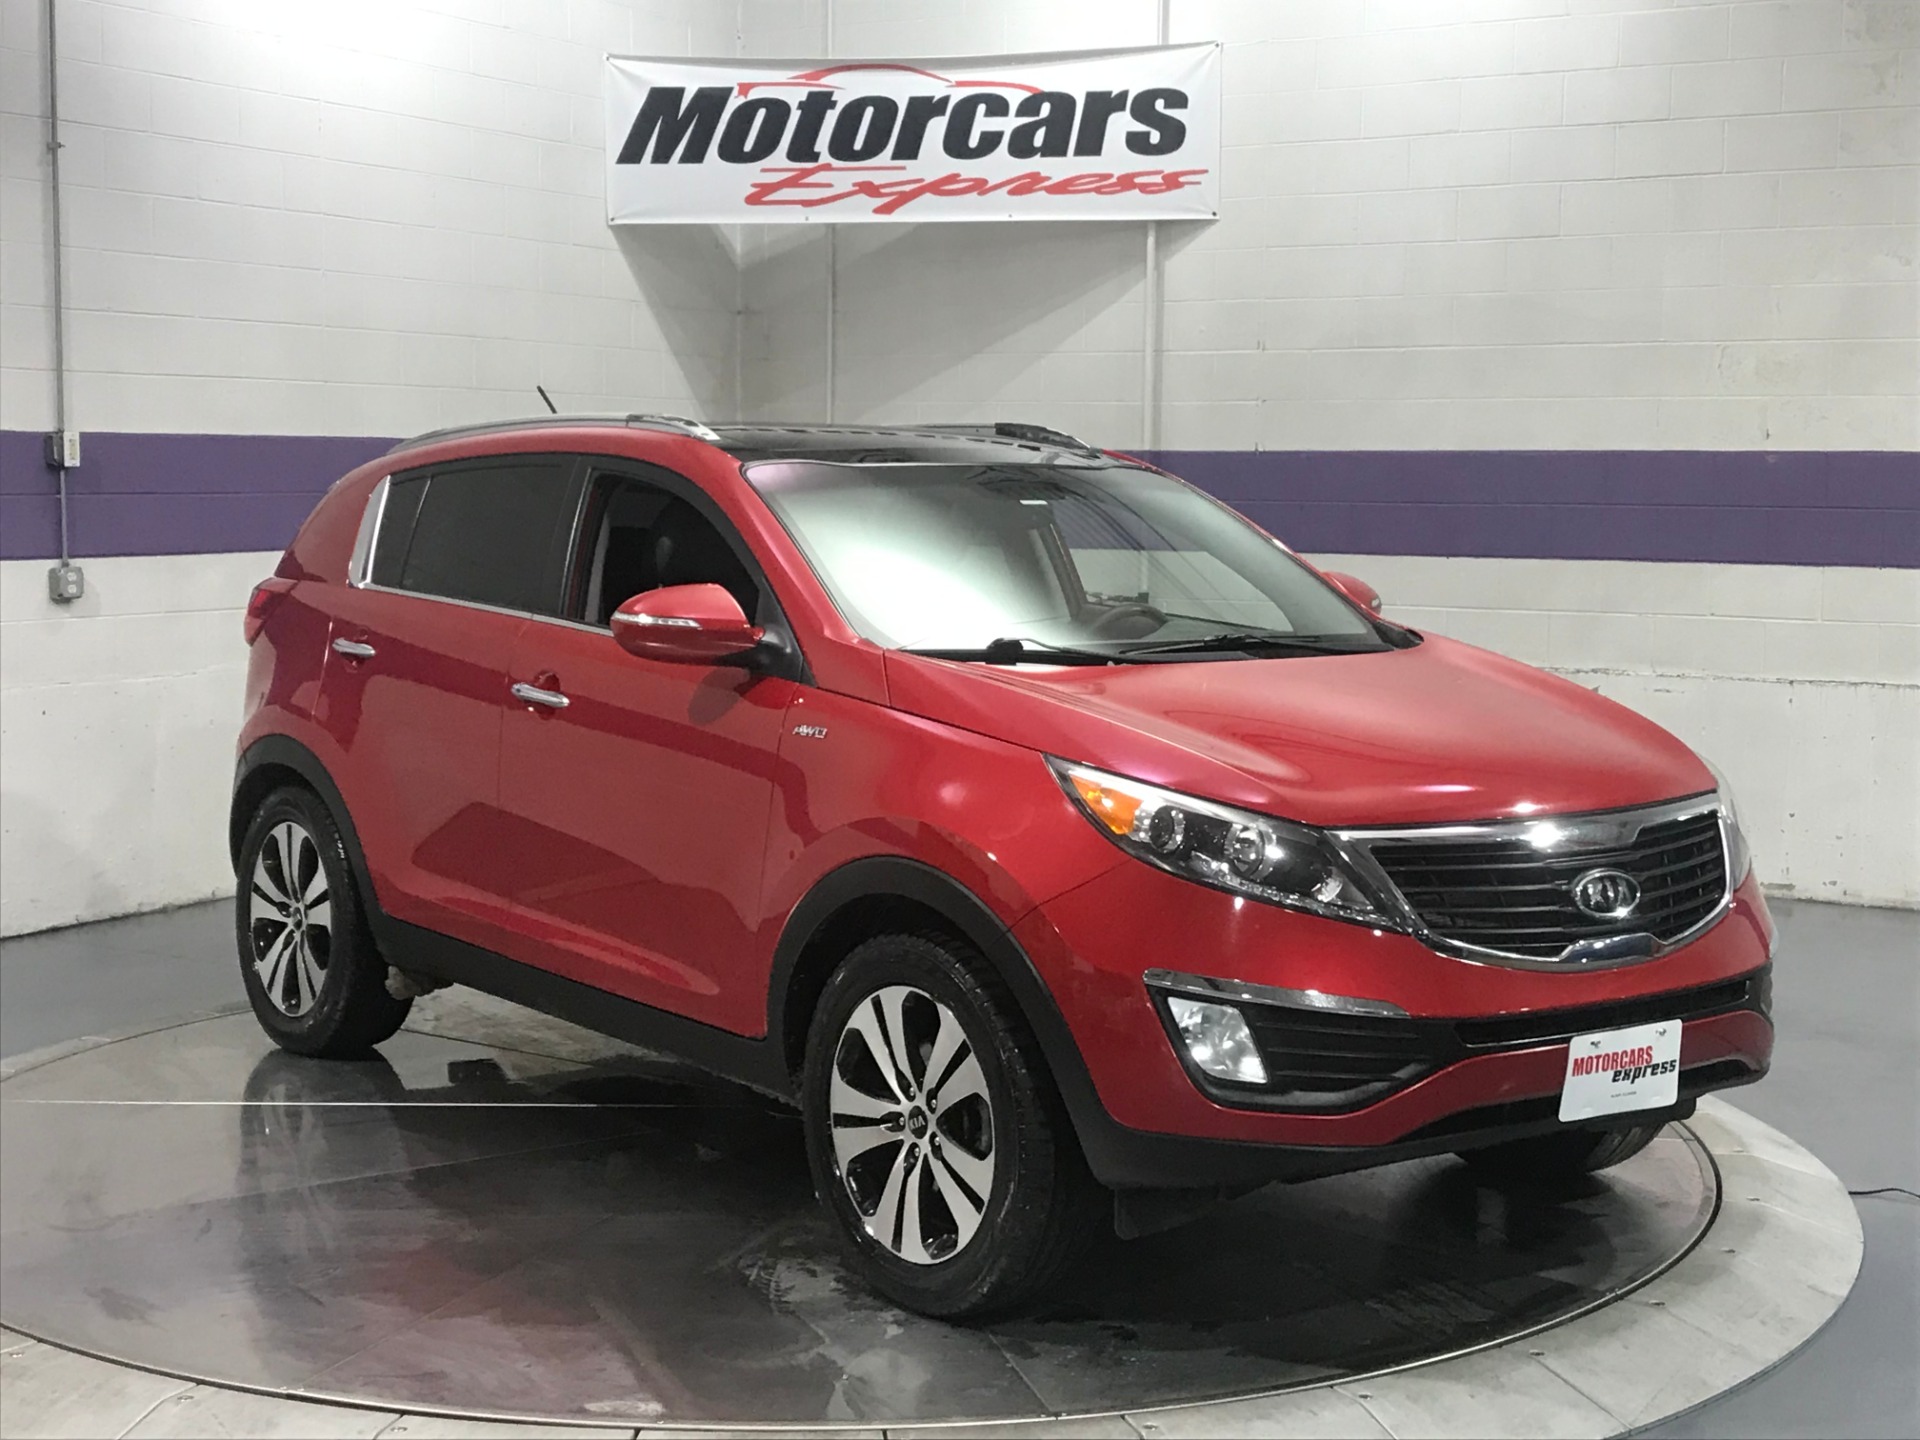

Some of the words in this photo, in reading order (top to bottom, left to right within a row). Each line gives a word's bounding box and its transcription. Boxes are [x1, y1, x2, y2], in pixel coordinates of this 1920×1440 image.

[615, 87, 1190, 165] Motorcars
[745, 163, 1209, 215] Express
[1586, 878, 1633, 909] KIA
[1571, 1045, 1653, 1077] MOTORCARS
[1611, 1059, 1677, 1085] express
